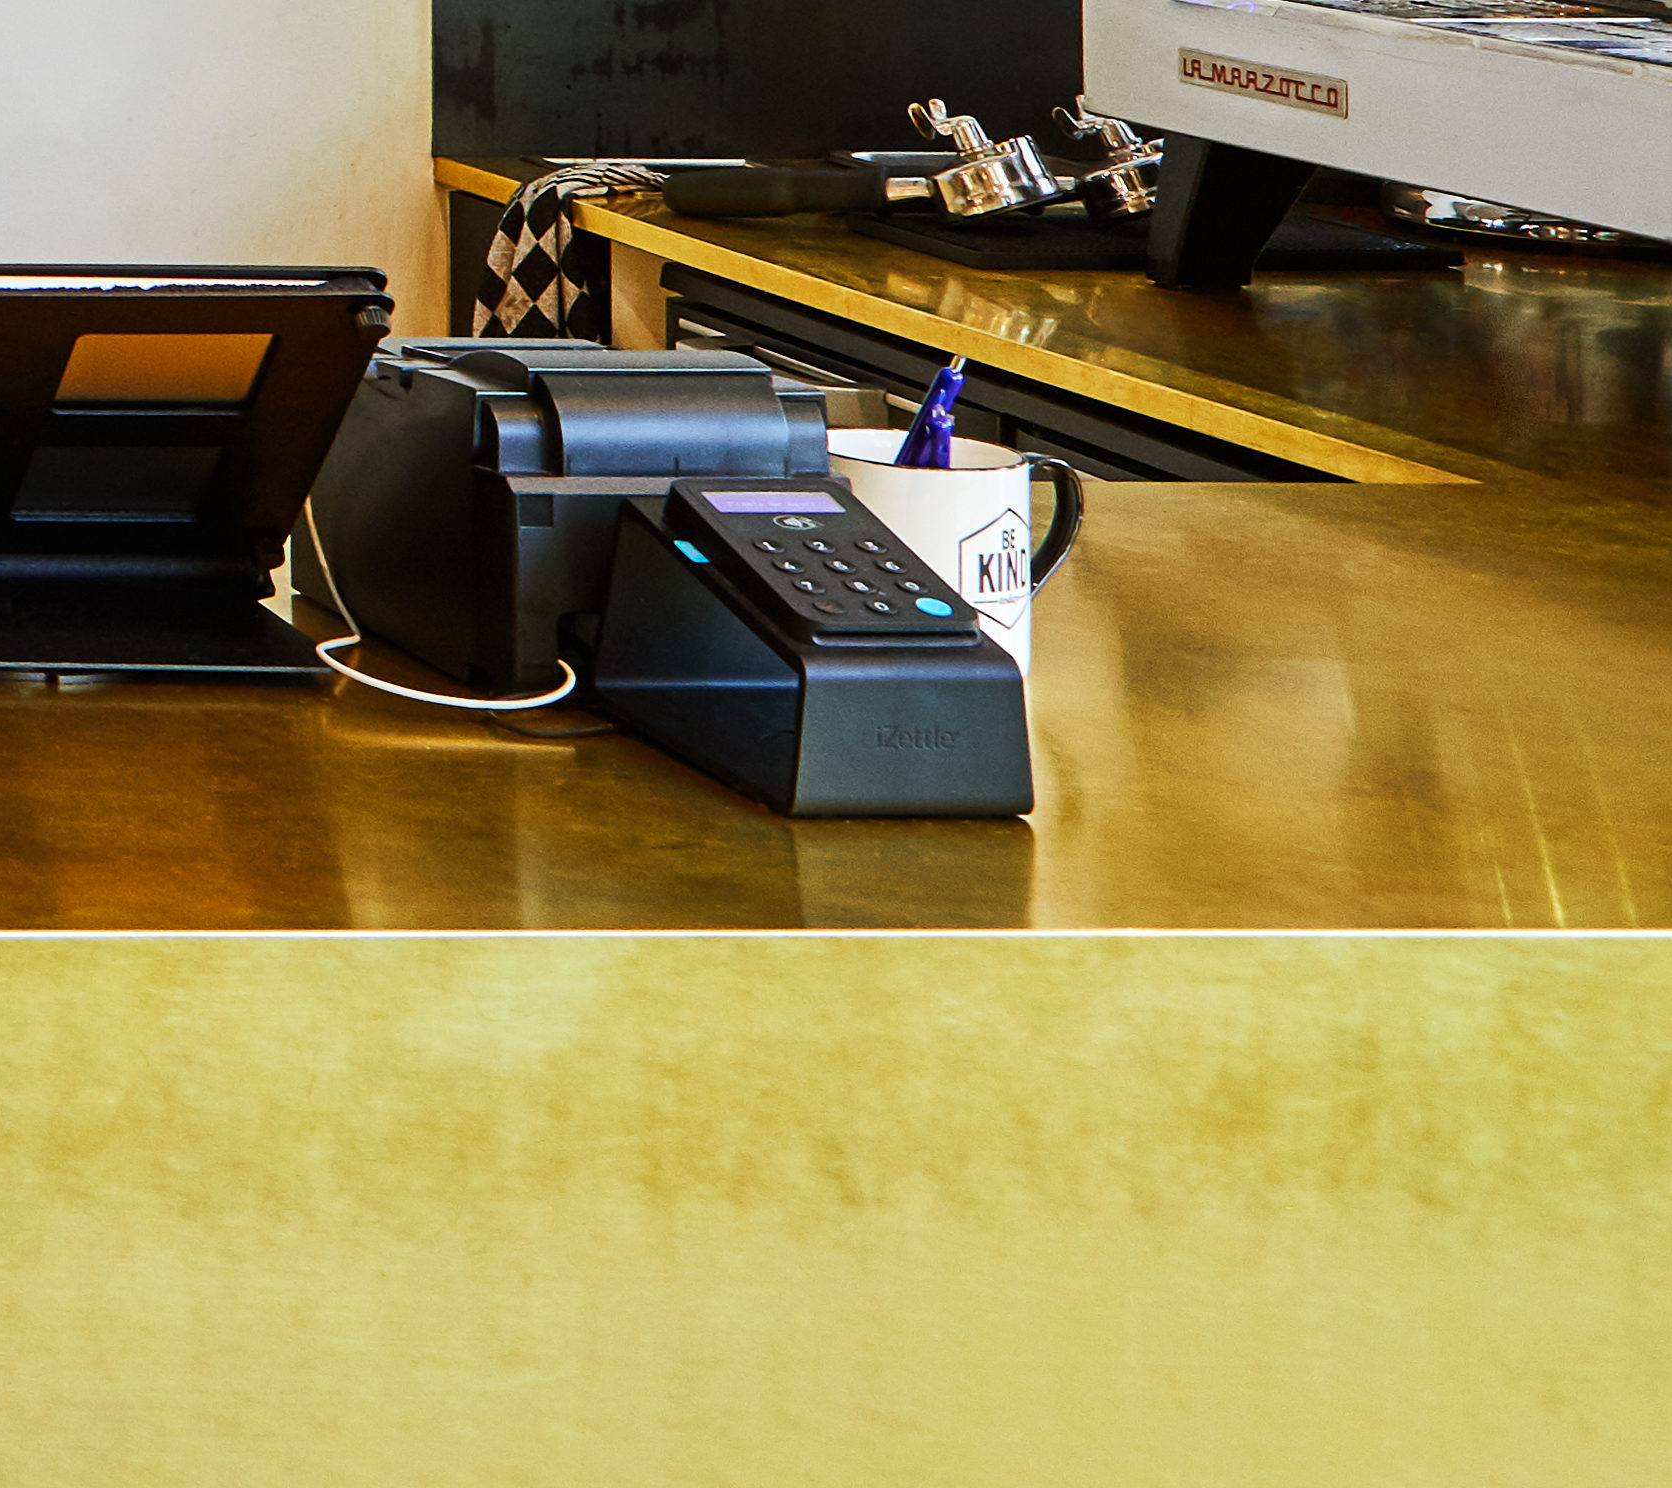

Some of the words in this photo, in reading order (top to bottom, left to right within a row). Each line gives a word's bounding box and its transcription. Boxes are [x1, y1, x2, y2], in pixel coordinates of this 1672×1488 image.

[1212, 63, 1339, 108] MARZOCCO
[1002, 528, 1016, 551] BE
[978, 549, 1028, 594] KIND
